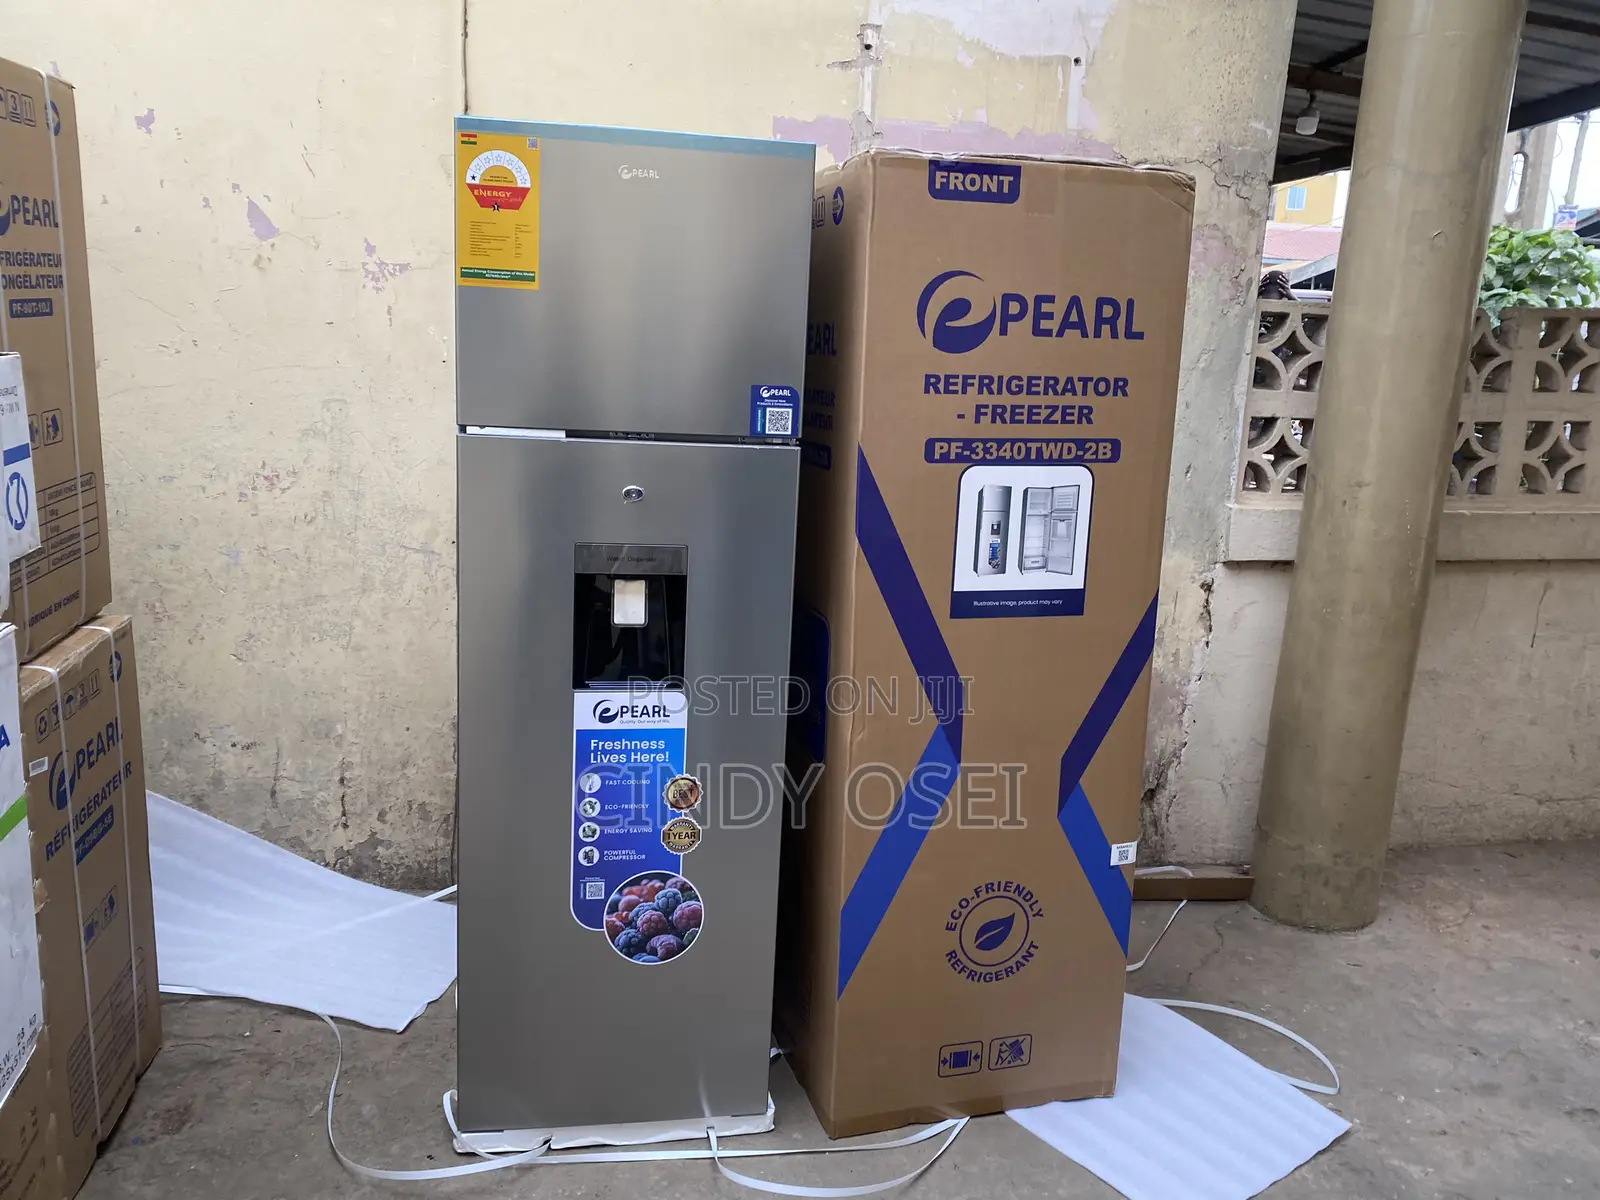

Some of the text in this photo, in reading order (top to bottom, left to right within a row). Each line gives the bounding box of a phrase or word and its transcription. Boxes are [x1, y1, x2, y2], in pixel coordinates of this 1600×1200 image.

[632, 168, 659, 179] PEARL
[934, 171, 1014, 194] FRONT
[473, 188, 512, 198] ENERGY
[10, 194, 58, 228] PEARL
[1, 271, 64, 290] ONGÉLATEUR
[999, 292, 1145, 341] PEARL
[807, 322, 837, 356] EARL
[923, 373, 1129, 398] REFRIGERATOR
[973, 403, 1094, 425] FREEZER
[933, 442, 1112, 461] PF-3340TWD-2B
[620, 705, 671, 718] PEARL
[590, 738, 665, 750] Freshness
[590, 751, 669, 763] Lives Here!
[672, 788, 694, 799] BEST
[669, 821, 695, 831] WARRANTY
[672, 831, 696, 840] YEAR
[945, 881, 1044, 932] ECO-FRIENDLY
[945, 940, 1040, 983] REFRIGERANT
